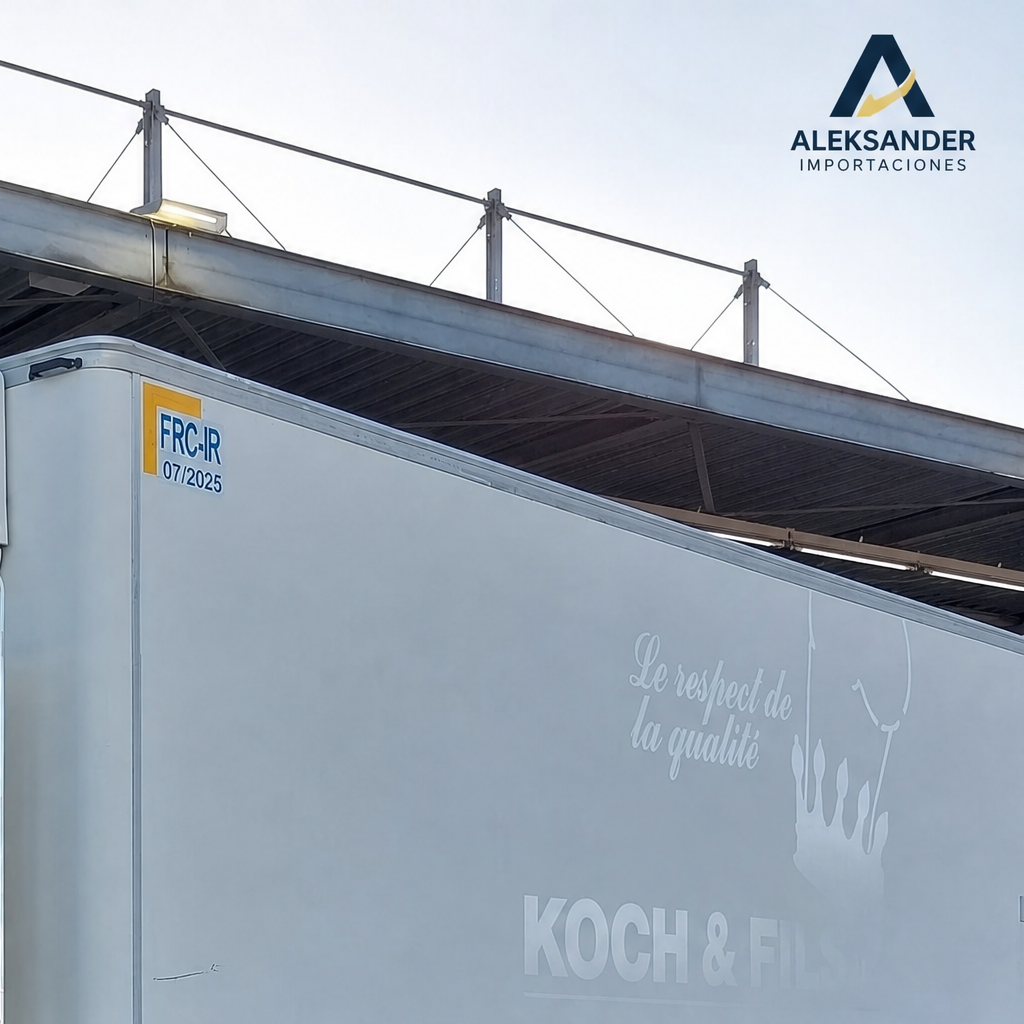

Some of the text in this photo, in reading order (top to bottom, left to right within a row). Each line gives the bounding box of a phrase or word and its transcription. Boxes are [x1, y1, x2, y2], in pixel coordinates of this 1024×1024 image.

[160, 412, 221, 465] FRC-IR
[162, 460, 222, 493] 07/2025
[628, 631, 793, 726] Le respect de
[630, 694, 760, 781] la qualité
[523, 893, 689, 984] KOCH
[701, 910, 738, 988] &
